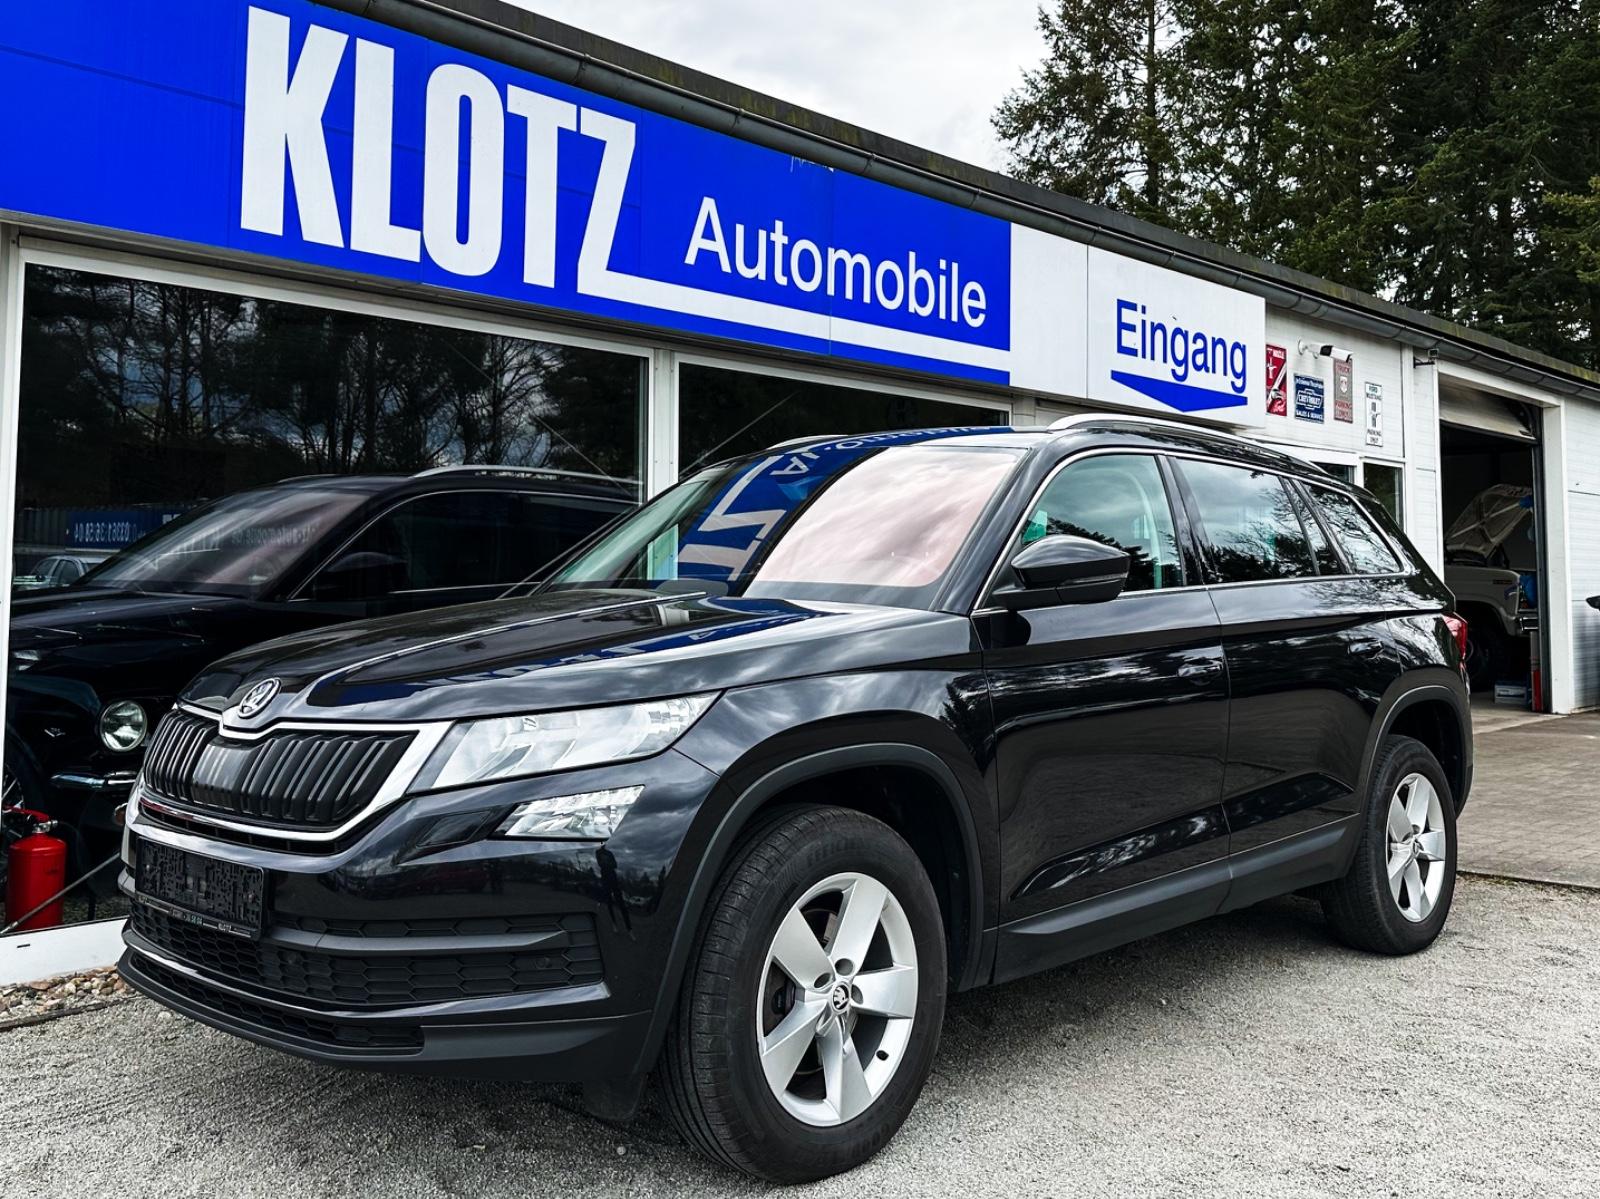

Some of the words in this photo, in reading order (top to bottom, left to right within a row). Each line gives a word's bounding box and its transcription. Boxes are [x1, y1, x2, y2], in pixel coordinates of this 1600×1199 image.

[241, 6, 637, 296] KLOTZ
[684, 196, 987, 328] Automobile
[1116, 298, 1247, 394] Eingang
